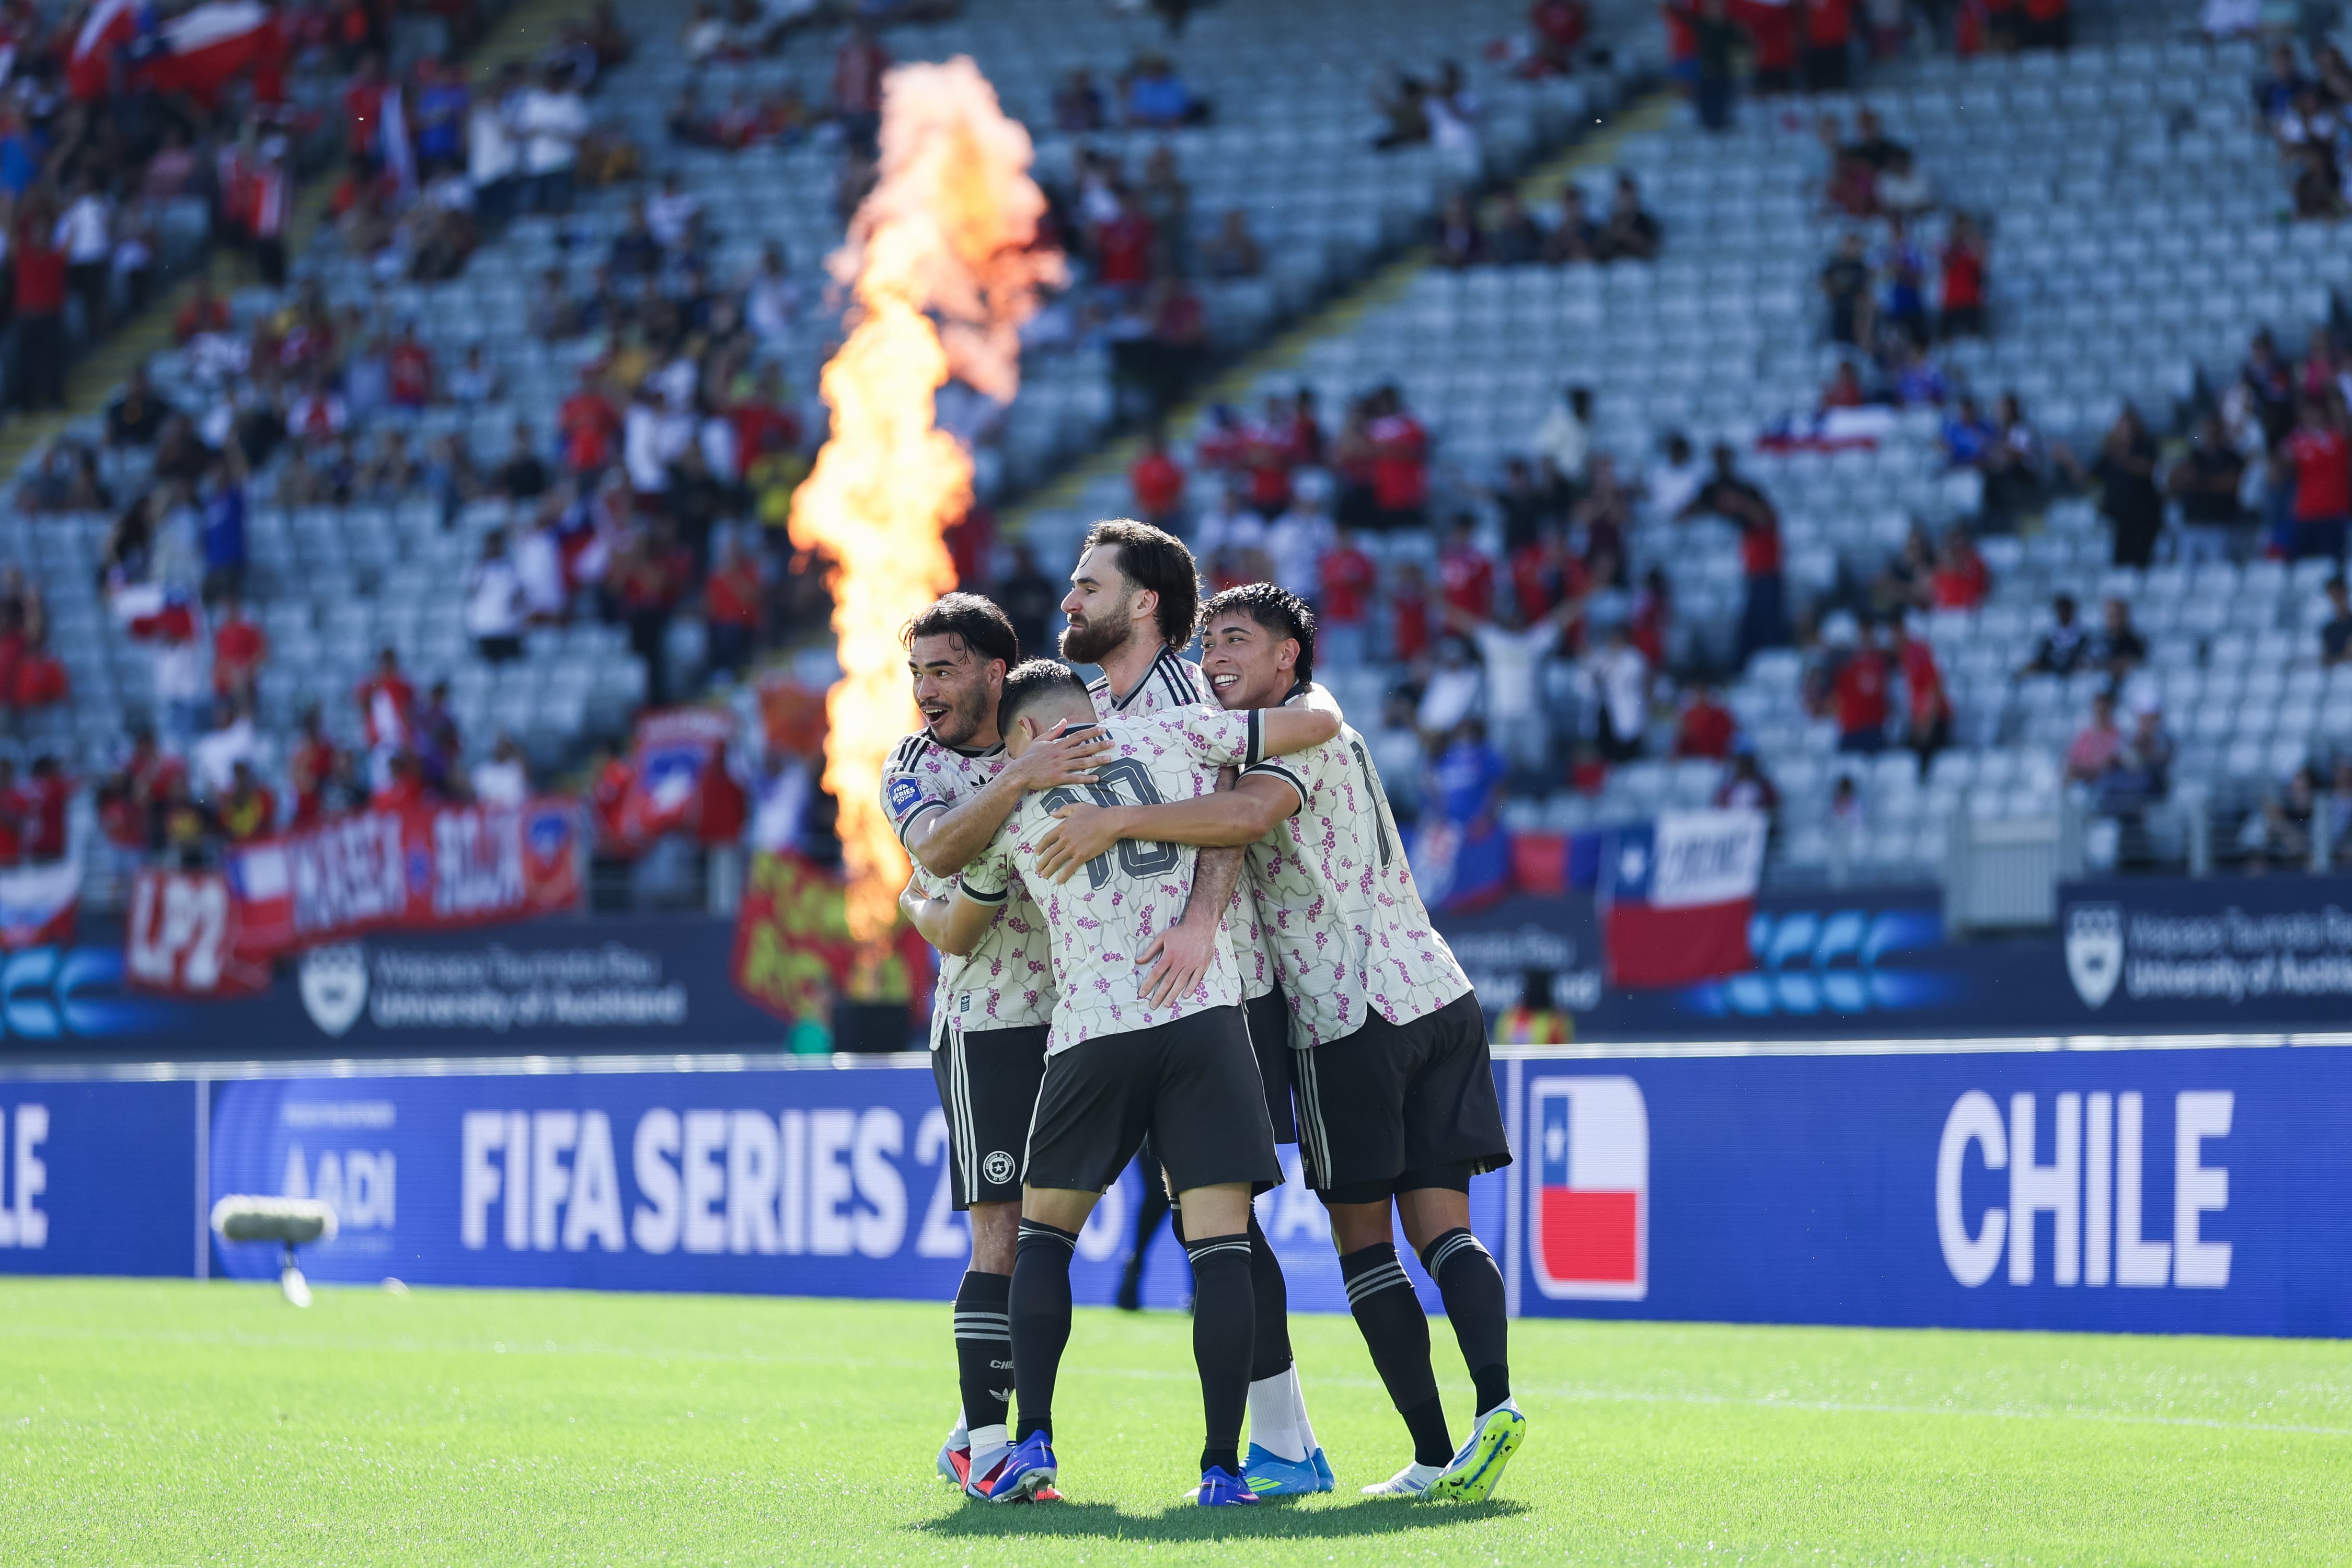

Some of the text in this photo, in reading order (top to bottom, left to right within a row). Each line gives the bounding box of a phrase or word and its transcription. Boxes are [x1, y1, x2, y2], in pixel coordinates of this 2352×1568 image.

[893, 787, 915, 802] SERIES
[894, 784, 908, 794] FIFA
[897, 793, 914, 805] 2026
[461, 1109, 626, 1252] FIFA
[631, 1105, 908, 1259] SERIES
[1935, 1088, 2234, 1288] CHILE
[990, 1360, 1014, 1369] CHIL
